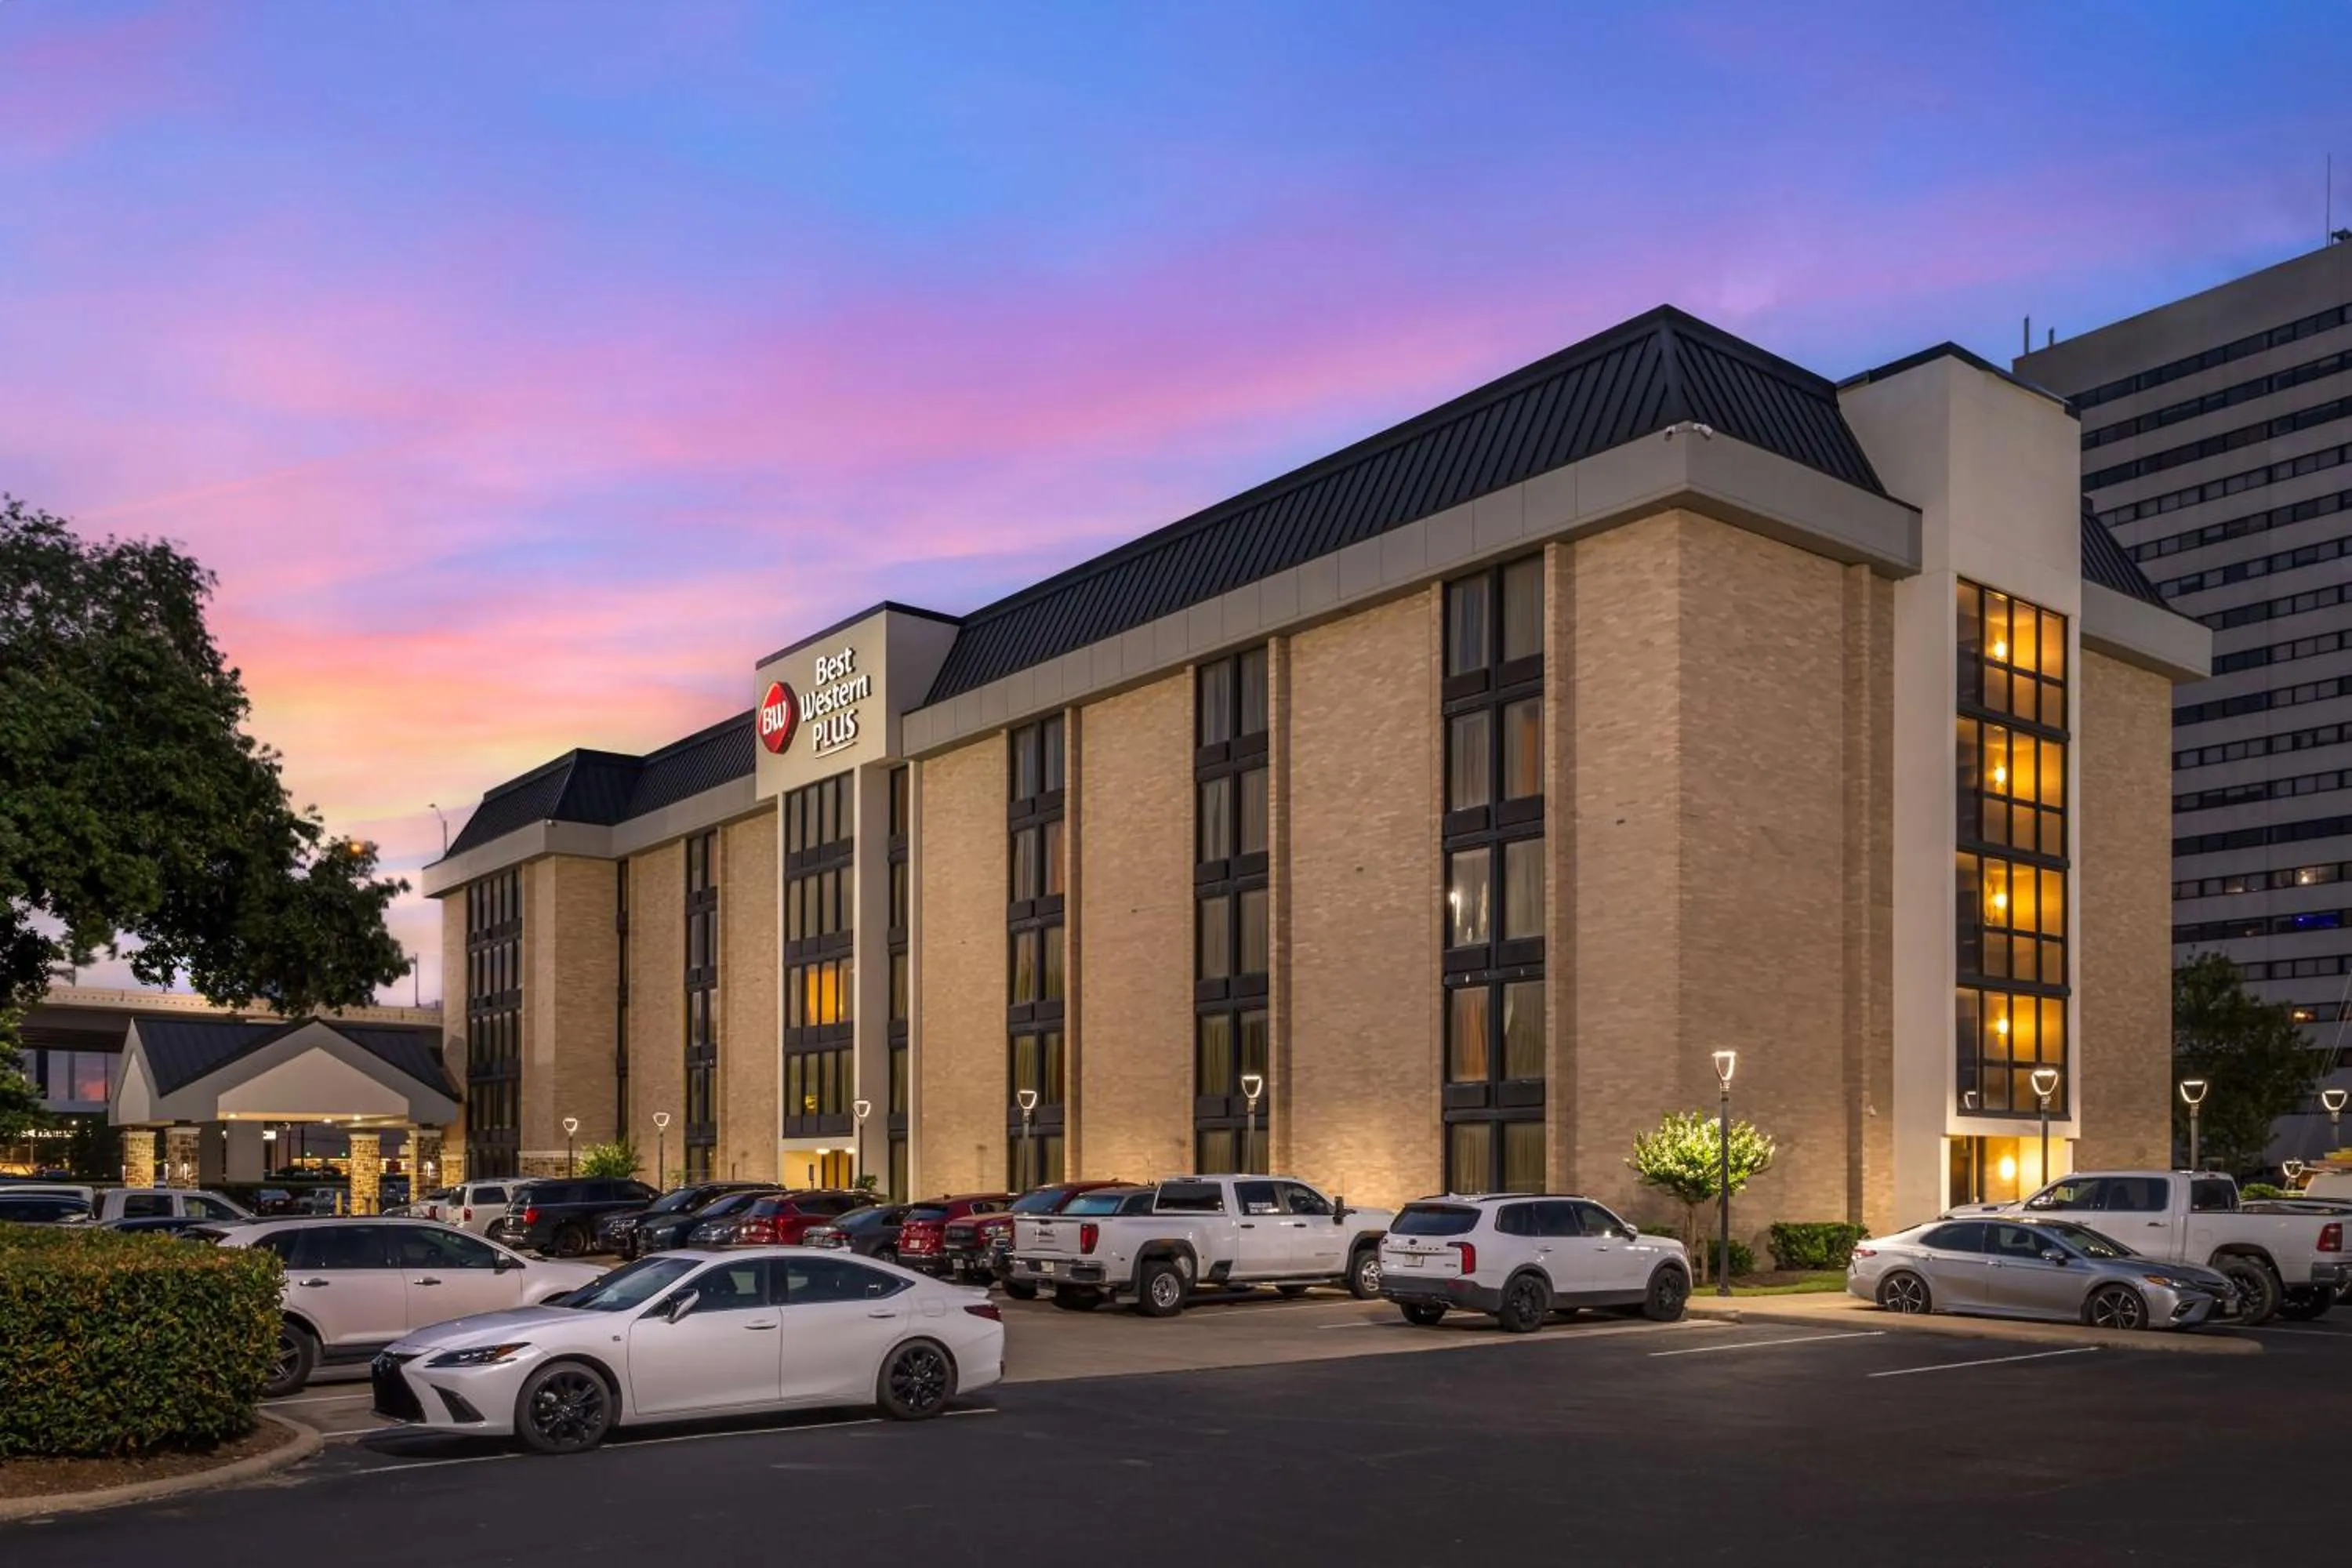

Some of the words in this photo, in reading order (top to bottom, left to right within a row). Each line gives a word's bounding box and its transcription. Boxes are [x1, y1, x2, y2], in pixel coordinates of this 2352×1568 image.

[815, 647, 853, 686] Best
[762, 700, 787, 735] BW
[800, 674, 869, 722] Western
[813, 709, 856, 751] PLUS
